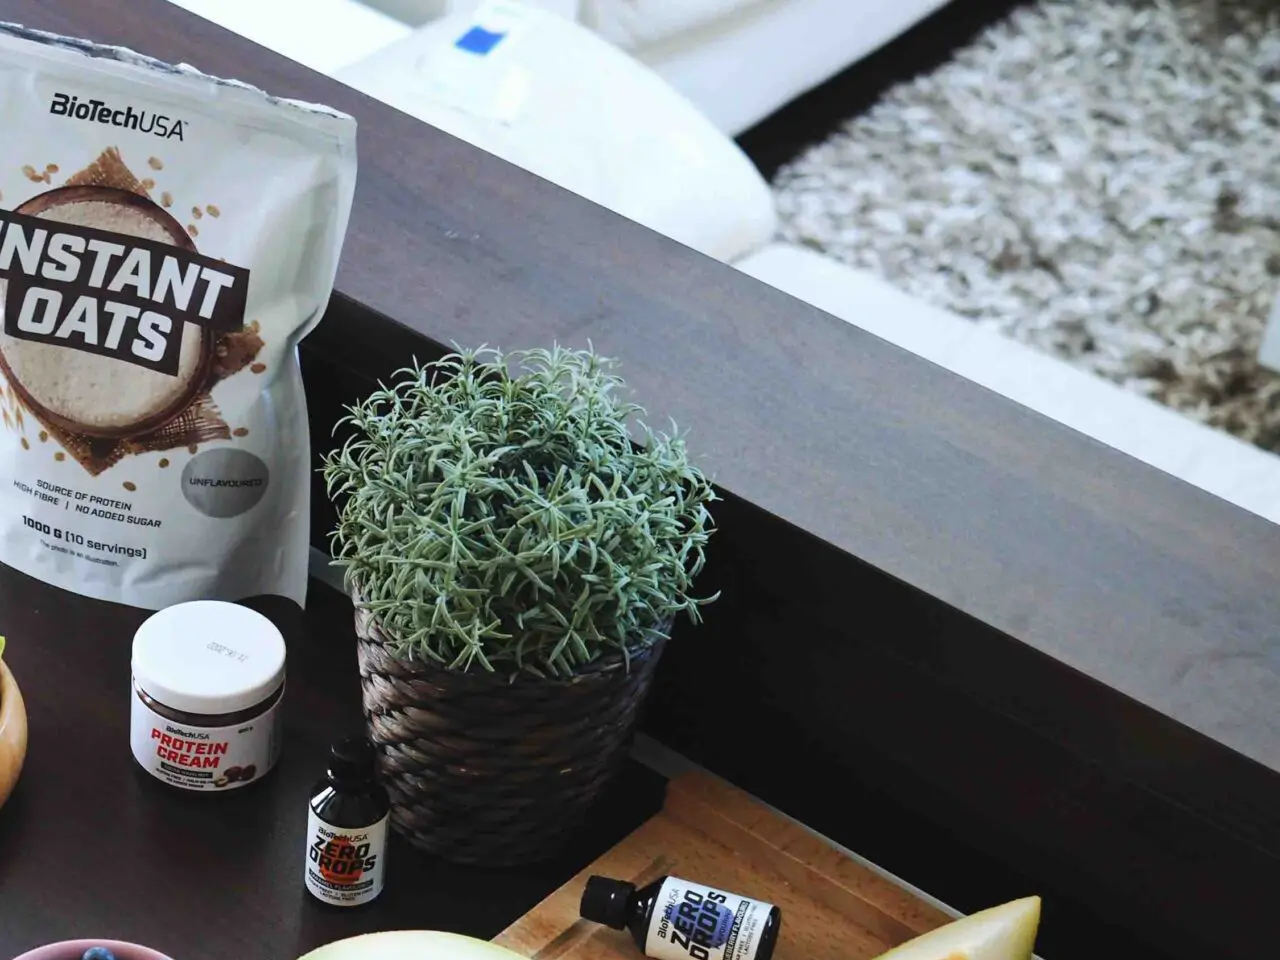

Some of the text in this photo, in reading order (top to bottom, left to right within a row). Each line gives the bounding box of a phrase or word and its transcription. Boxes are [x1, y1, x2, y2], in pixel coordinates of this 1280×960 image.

[17, 286, 172, 362] OATS
[37, 479, 132, 511] SOURCE OF PROTEIN
[189, 477, 262, 488] UNFLAVOURED
[13, 480, 33, 495] HIGH
[34, 490, 59, 505] FIBRE
[75, 504, 89, 514] NO
[90, 508, 125, 522] ADDED
[126, 515, 162, 528] SUGAR
[22, 515, 51, 535] 1000
[53, 528, 62, 539] G
[151, 728, 228, 755] PROTEIN
[157, 745, 220, 768] CREAM
[310, 844, 377, 874] DROPS
[314, 835, 371, 859] ZERO
[670, 890, 703, 950] ZERO
